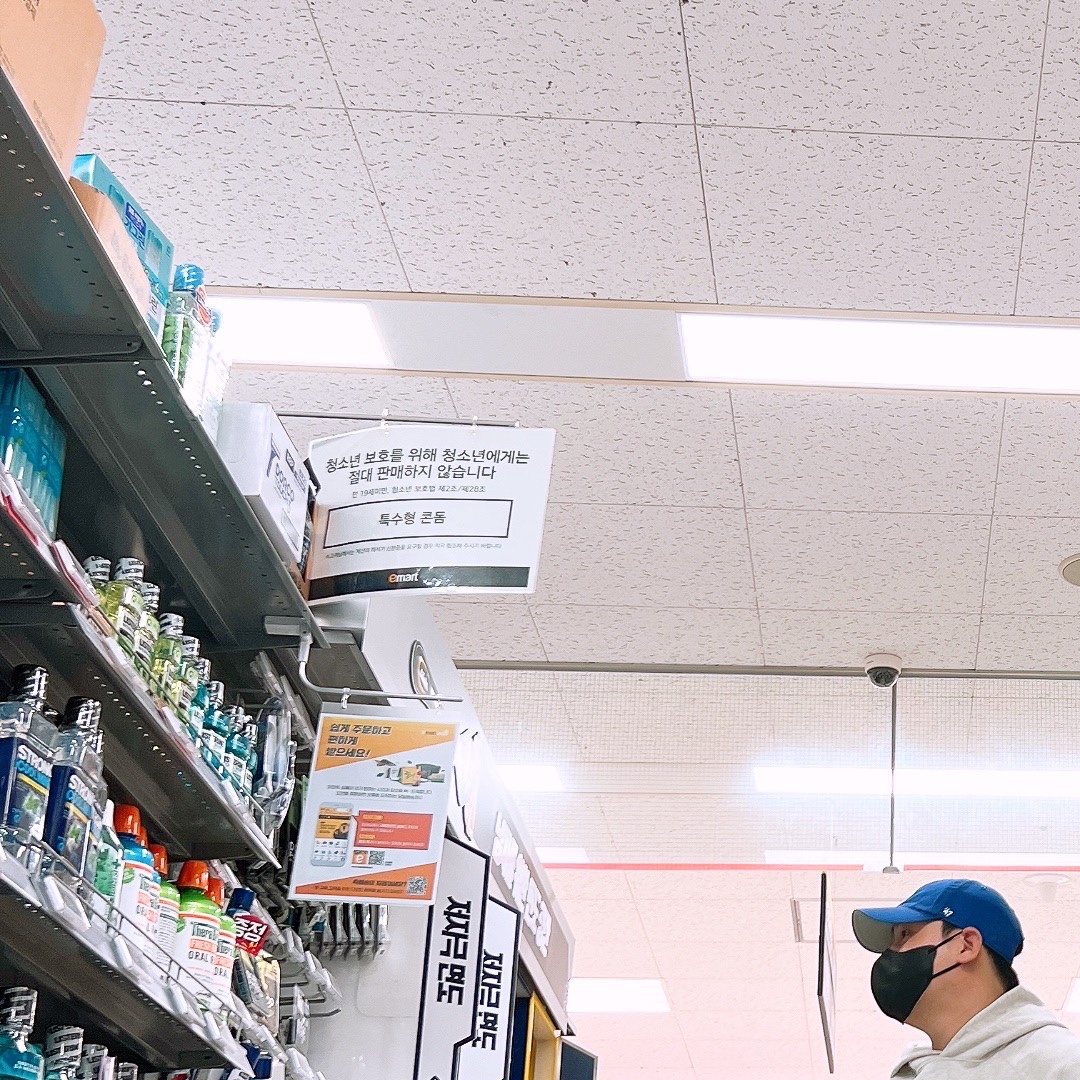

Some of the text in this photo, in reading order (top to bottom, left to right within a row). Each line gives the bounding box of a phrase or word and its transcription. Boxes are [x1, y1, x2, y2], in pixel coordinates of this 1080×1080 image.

[325, 447, 531, 473] 청소년 보호를 위해 청소년에게는
[349, 464, 496, 485] 절대 판매하지 않습니다
[378, 511, 447, 526] 특수형 콘돔
[388, 570, 420, 584] emart
[328, 722, 392, 736] 쉽게 주문하고
[326, 735, 359, 746] 편하게
[437, 896, 473, 1006] 저자극 면도
